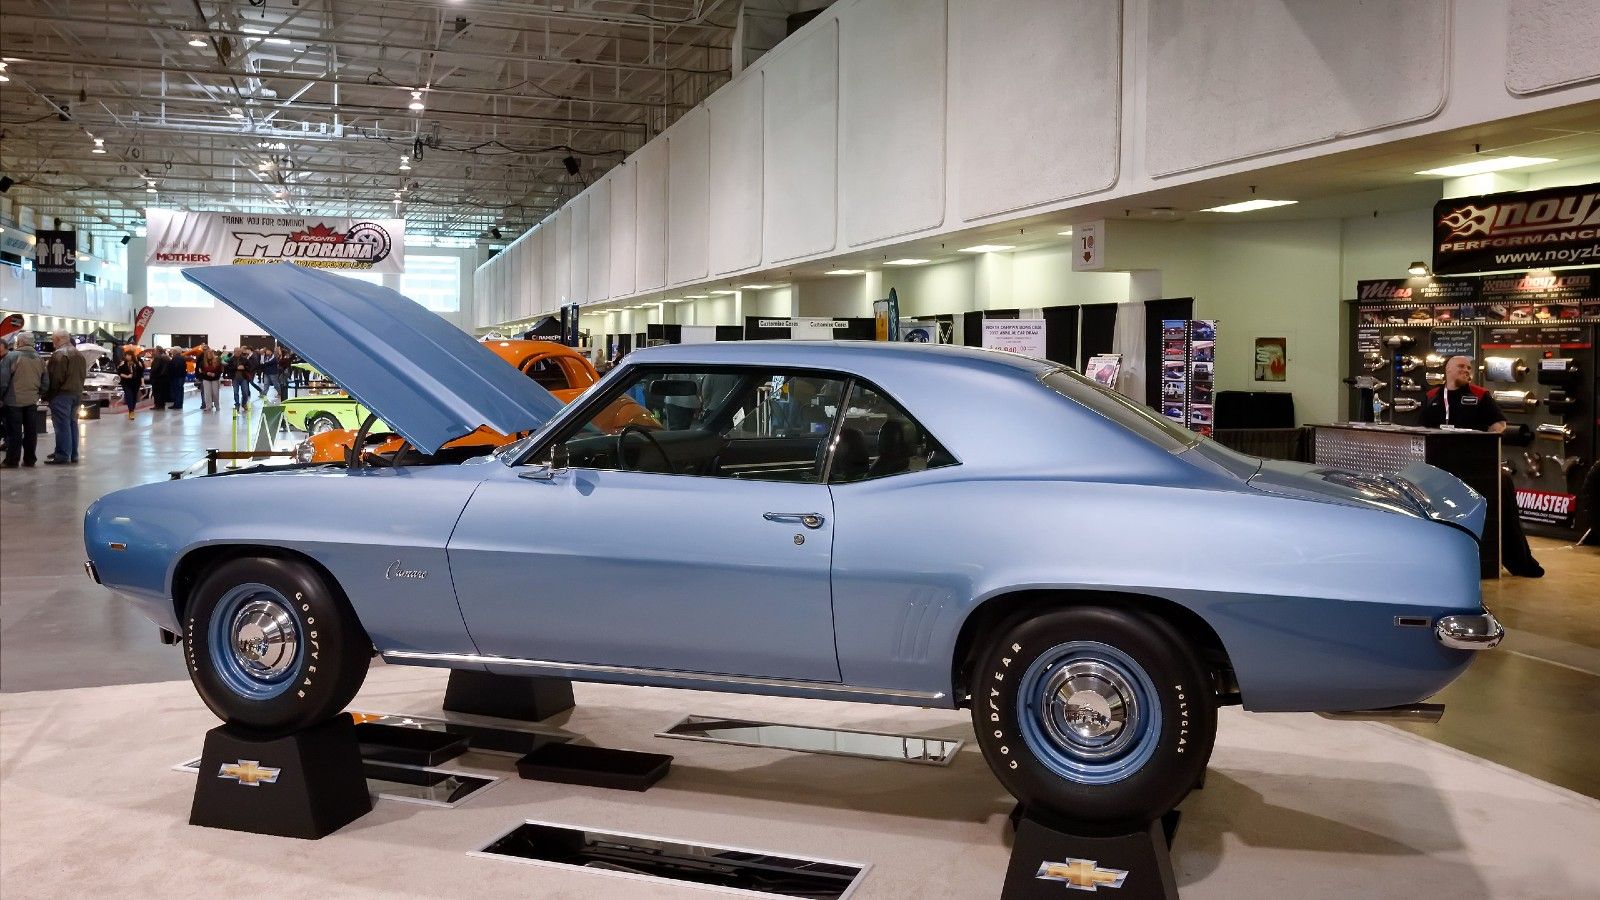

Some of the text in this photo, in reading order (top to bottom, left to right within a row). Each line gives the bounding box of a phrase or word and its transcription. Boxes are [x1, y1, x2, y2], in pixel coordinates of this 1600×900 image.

[222, 215, 305, 227] THANK YOU FOR COMING!
[231, 231, 374, 260] MOTORAMA
[156, 253, 211, 262] MOTHERS
[295, 591, 320, 698] GOODYEAR
[989, 642, 1022, 770] GOODYEAR
[1175, 684, 1188, 754] POLYGLAS
